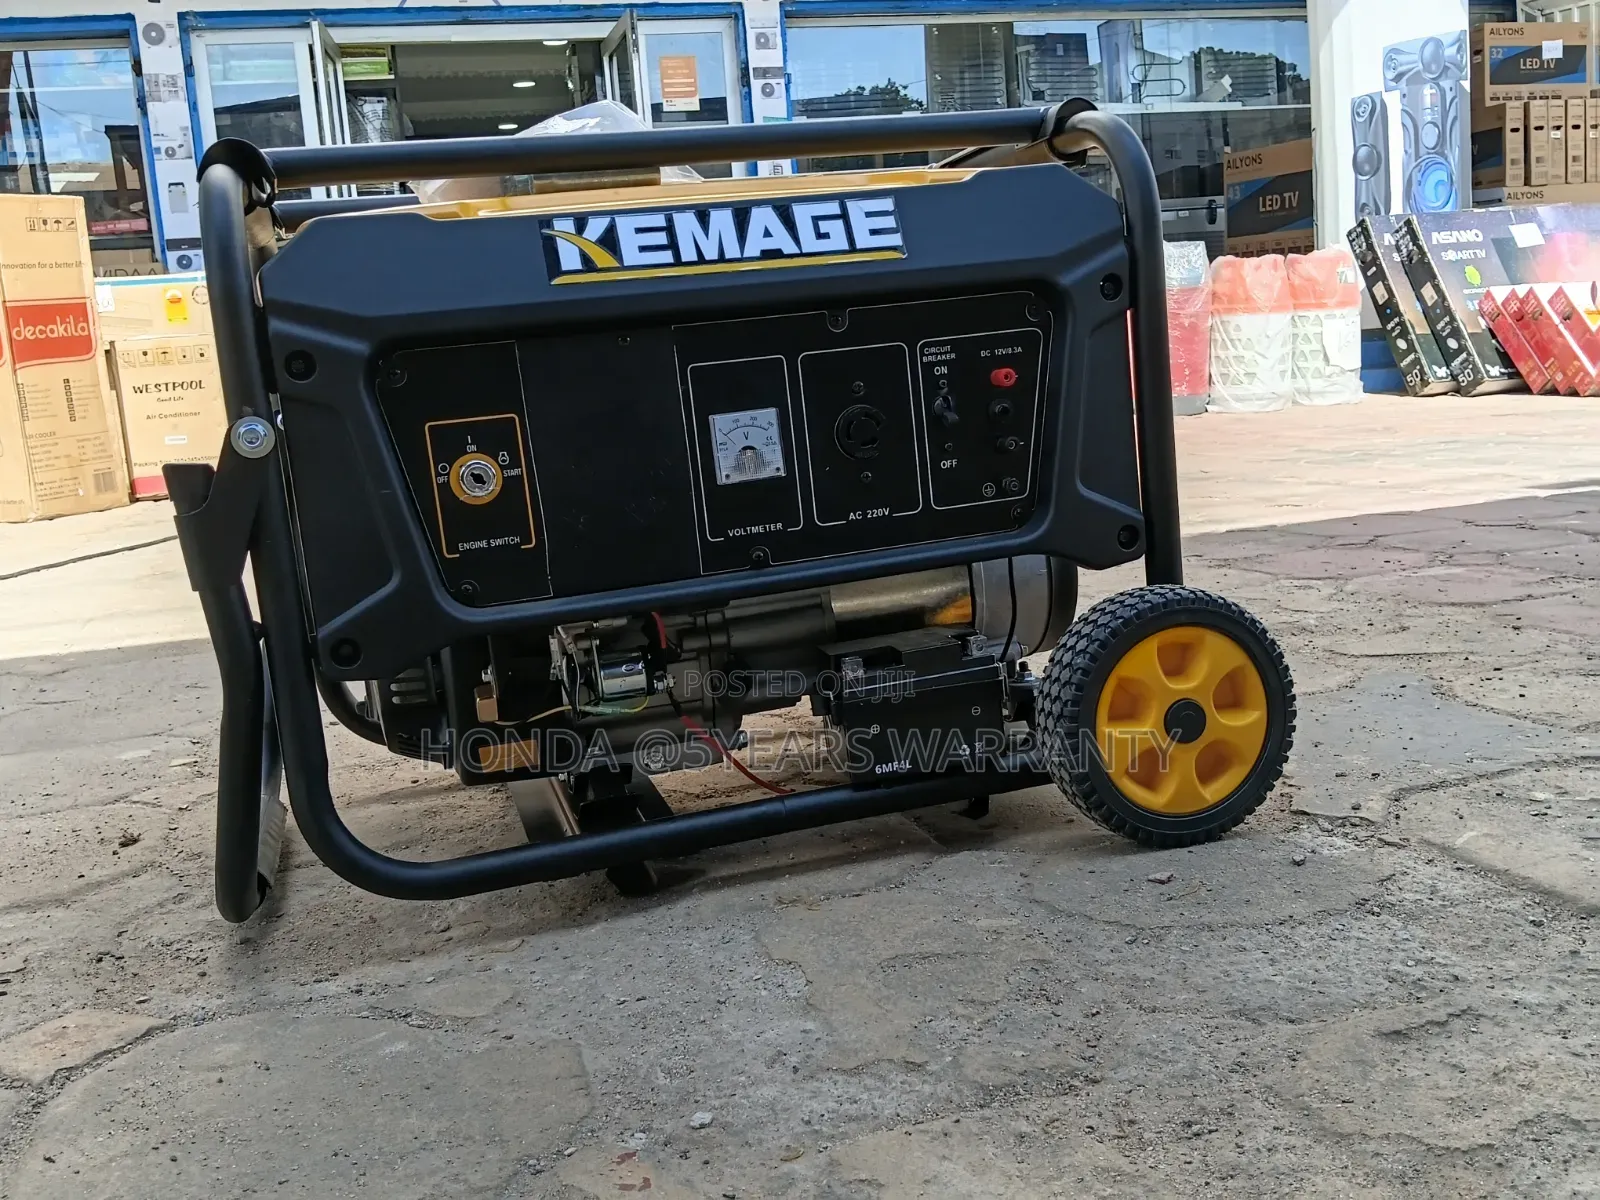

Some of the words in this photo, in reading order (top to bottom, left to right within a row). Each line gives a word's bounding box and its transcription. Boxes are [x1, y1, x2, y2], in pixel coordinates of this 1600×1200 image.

[1489, 27, 1525, 36] AILYONS
[1520, 58, 1540, 69] LED
[1226, 153, 1263, 171] AILYONS
[1506, 190, 1544, 200] AILYONS
[1259, 194, 1281, 212] LED
[1283, 191, 1299, 209] TV
[551, 197, 904, 271] KEMAGE
[1431, 228, 1484, 244] ASANO
[38, 261, 48, 269] for
[55, 261, 74, 269] better
[923, 345, 951, 355] CIRCUIT
[922, 353, 956, 363] BREAKER
[934, 365, 948, 376] ON
[132, 380, 206, 394] WESTPOOL
[158, 411, 201, 420] Conditioner
[742, 431, 749, 441] V
[466, 444, 477, 452] ON
[940, 458, 958, 469] OFF
[503, 468, 522, 477] START
[437, 475, 449, 484] OFF
[849, 511, 863, 521] AC
[866, 507, 890, 519] 220V
[727, 522, 783, 538] VOLTMETER
[458, 540, 489, 551] ENGINE
[490, 536, 521, 547] SWITCH
[874, 759, 914, 775] 6MF4L
